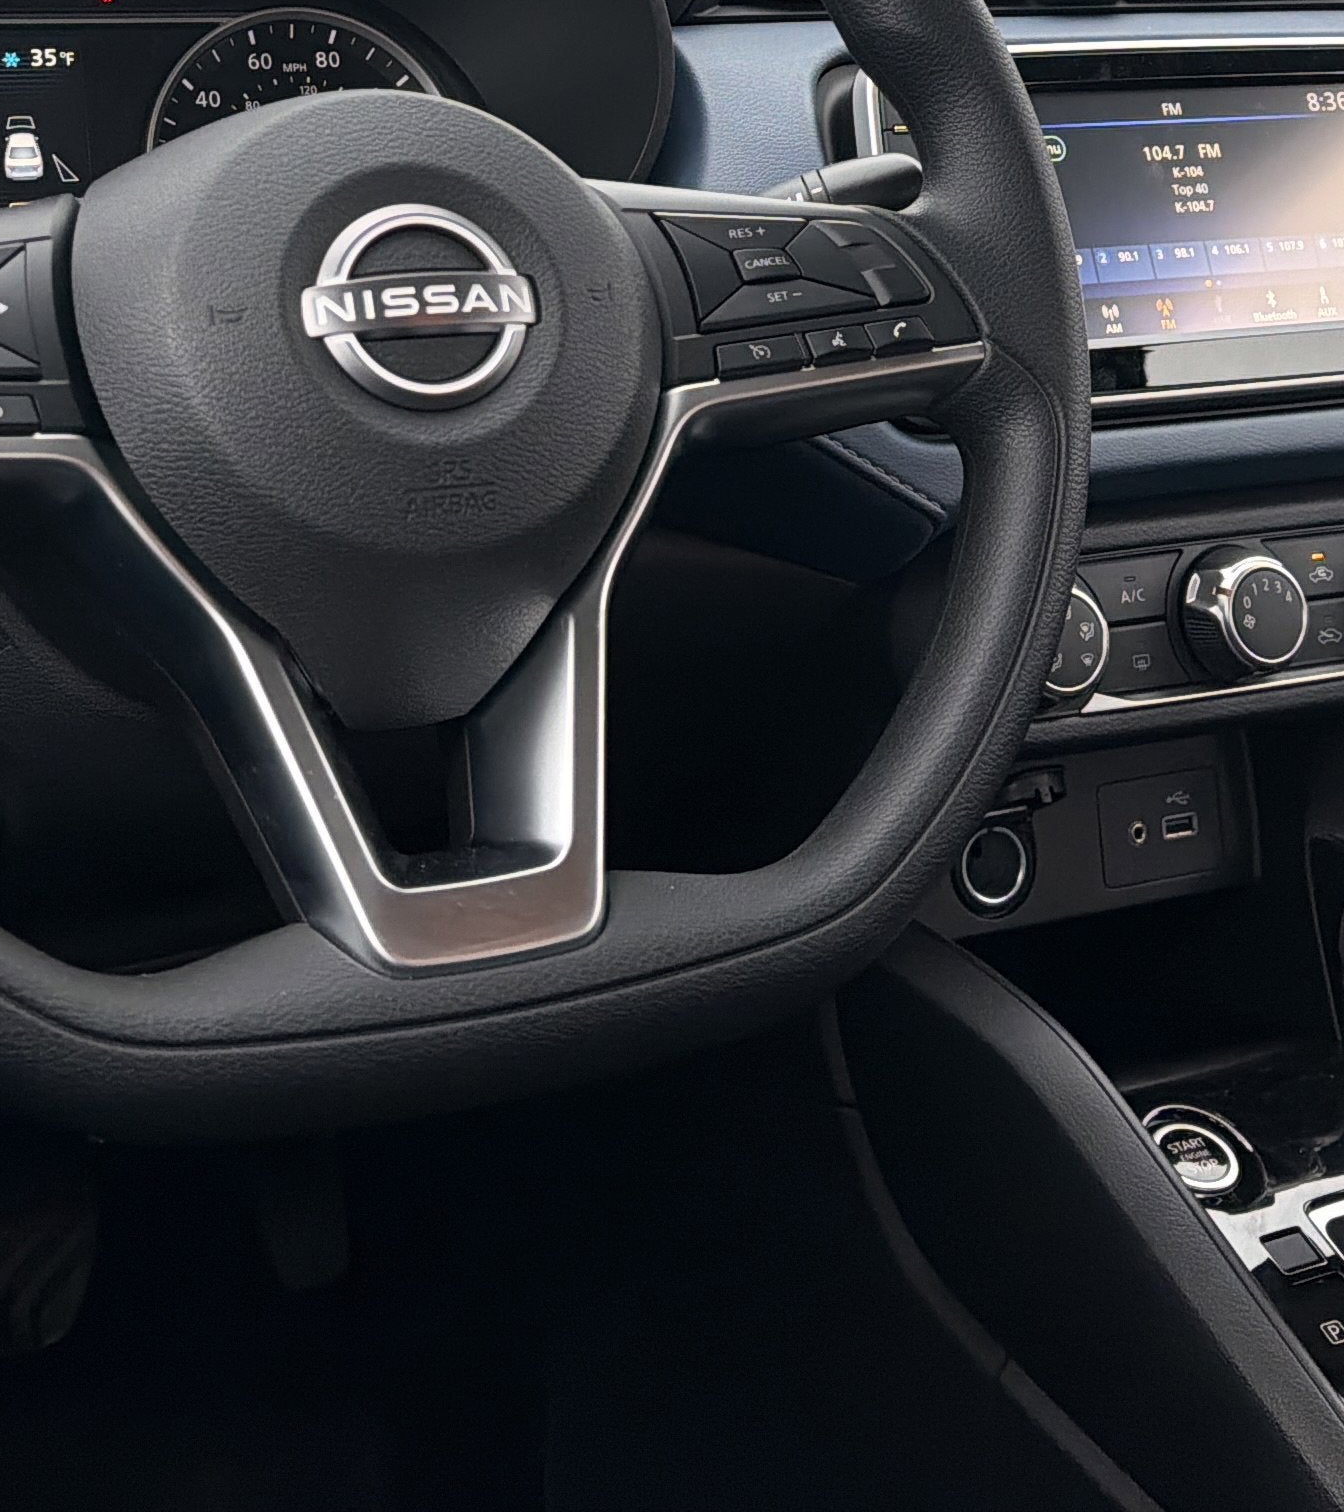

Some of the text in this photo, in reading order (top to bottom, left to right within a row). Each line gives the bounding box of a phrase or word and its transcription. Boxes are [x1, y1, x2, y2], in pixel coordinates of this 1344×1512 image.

[248, 51, 340, 70] 60 80
[282, 63, 307, 73] MPH
[195, 90, 221, 108] 40
[1161, 102, 1183, 117] FM
[1142, 143, 1221, 163] 104.7 FM
[1172, 165, 1204, 179] K-104
[1171, 183, 1209, 197] Top 40
[1175, 199, 1214, 214] K-104.7
[728, 227, 753, 238] RES
[745, 255, 790, 269] CANCEL
[767, 291, 788, 303] SET
[315, 284, 532, 327] NISSAN
[1253, 309, 1298, 322] Bluetooth
[1106, 323, 1124, 335] AM
[1121, 588, 1146, 605] A/C
[1243, 596, 1251, 608] 0
[1262, 579, 1270, 591] 2
[1275, 581, 1282, 593] 3
[1286, 590, 1293, 602] 4
[1167, 1137, 1206, 1155] START
[1328, 1325, 1341, 1339] P
